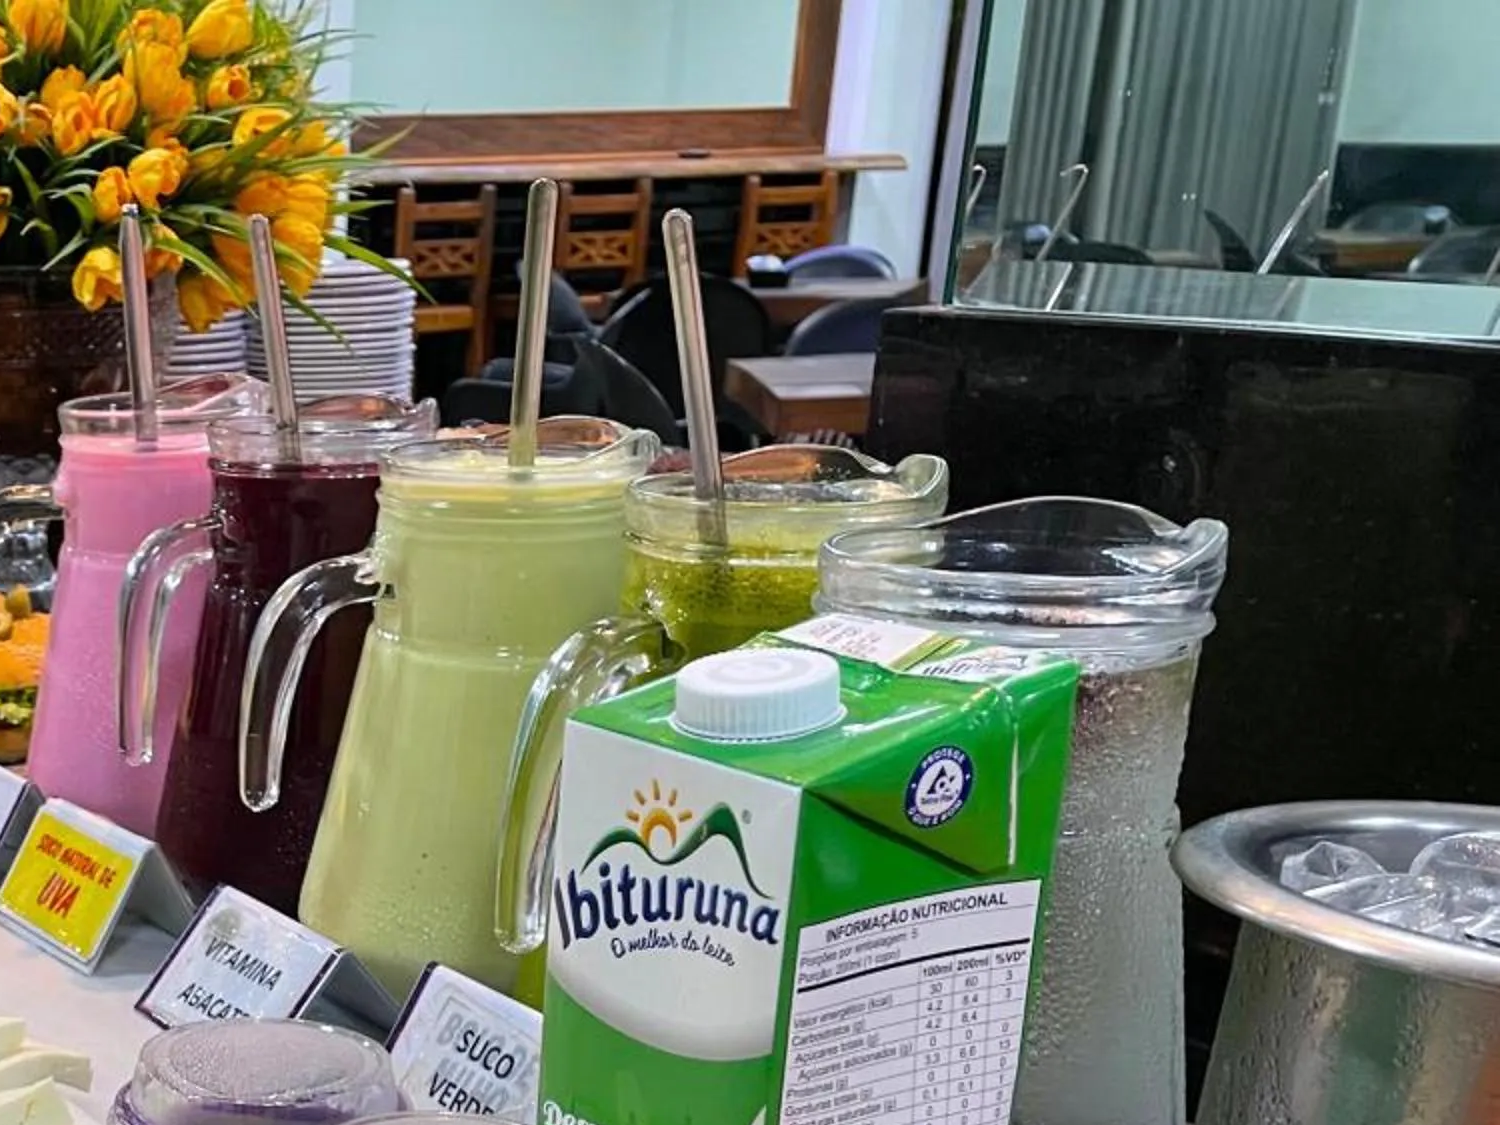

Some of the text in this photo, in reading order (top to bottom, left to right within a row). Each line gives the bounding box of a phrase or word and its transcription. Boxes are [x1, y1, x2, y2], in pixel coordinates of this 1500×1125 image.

[37, 872, 81, 919] UVA
[554, 862, 781, 951] Ibituruna
[826, 892, 1008, 942] INFORMAÇÃO NUTRICIONAL
[205, 937, 283, 992] VITAMINA
[610, 937, 625, 959] O
[177, 983, 250, 1020] ABACAT
[456, 1028, 515, 1079] SUCO
